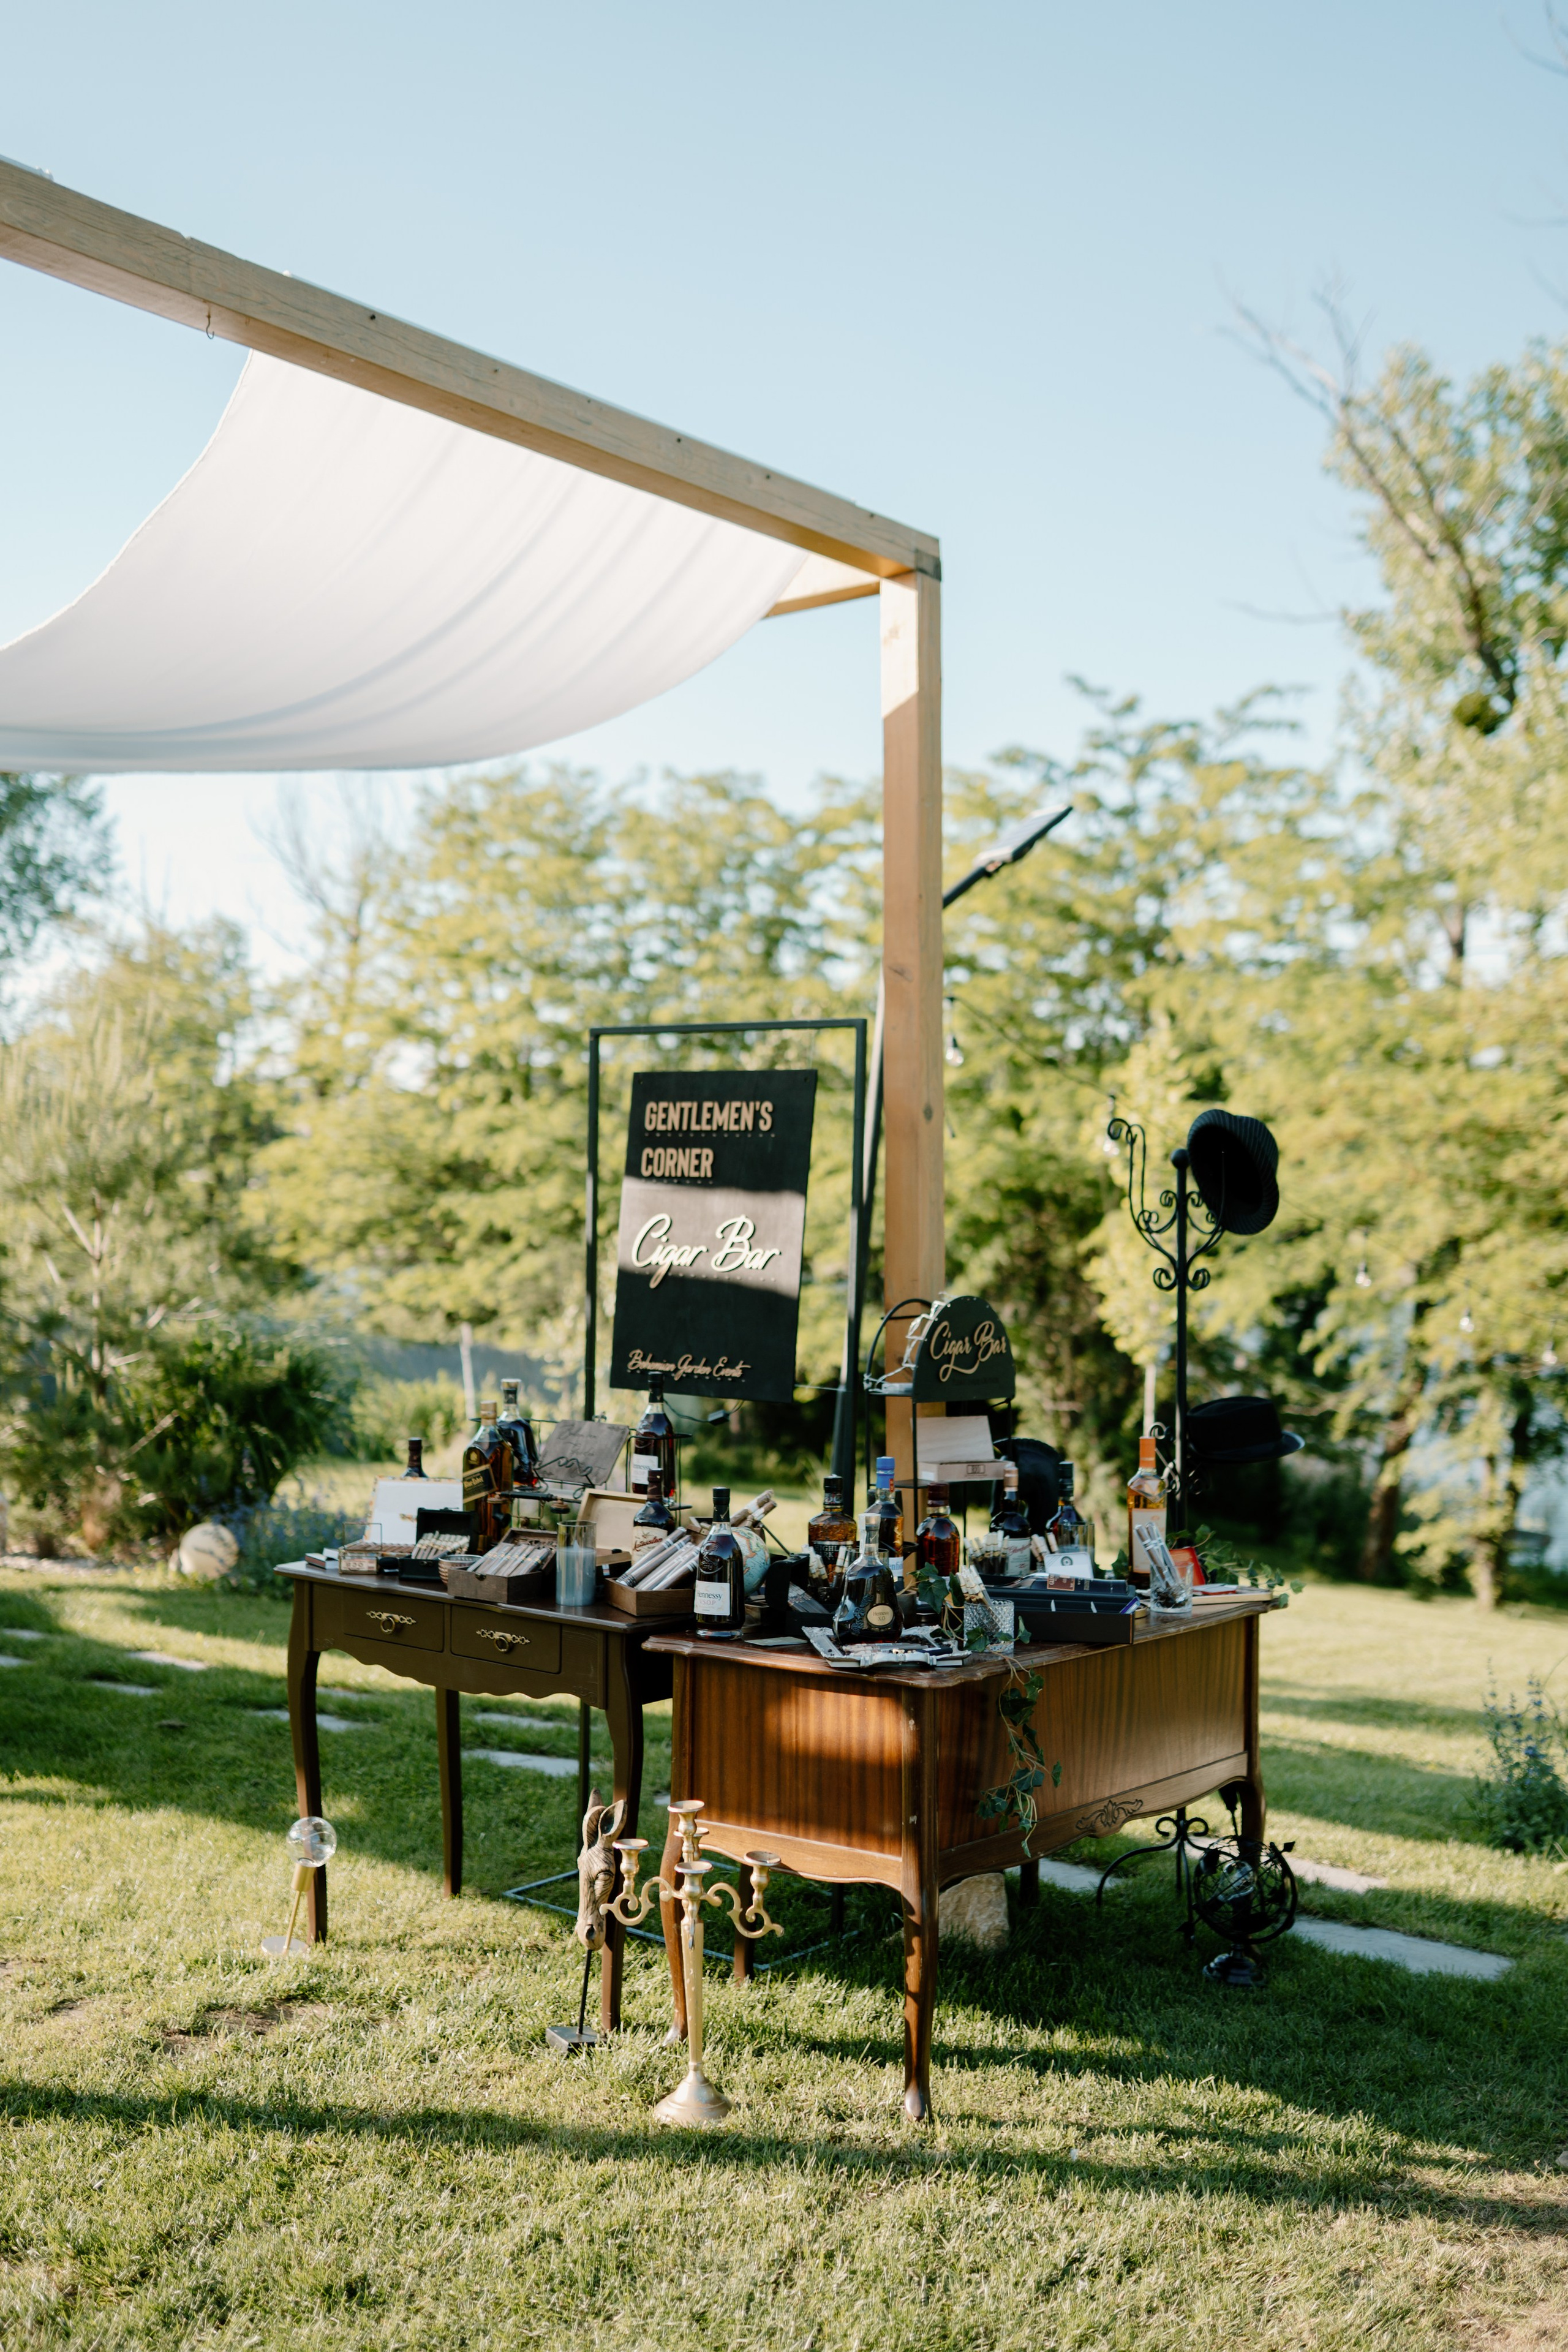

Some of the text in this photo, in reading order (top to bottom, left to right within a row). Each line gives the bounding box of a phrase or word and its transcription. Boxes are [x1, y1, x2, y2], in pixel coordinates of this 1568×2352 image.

[644, 1101, 774, 1131] GENTLEMEN'S
[641, 1147, 714, 1178] CORNER
[631, 1213, 781, 1289] Cigar Bar
[627, 1349, 751, 1381] Bohemian Garden Events
[930, 1321, 1006, 1382] Cigar Bar
[697, 1590, 723, 1600] Hennessy
